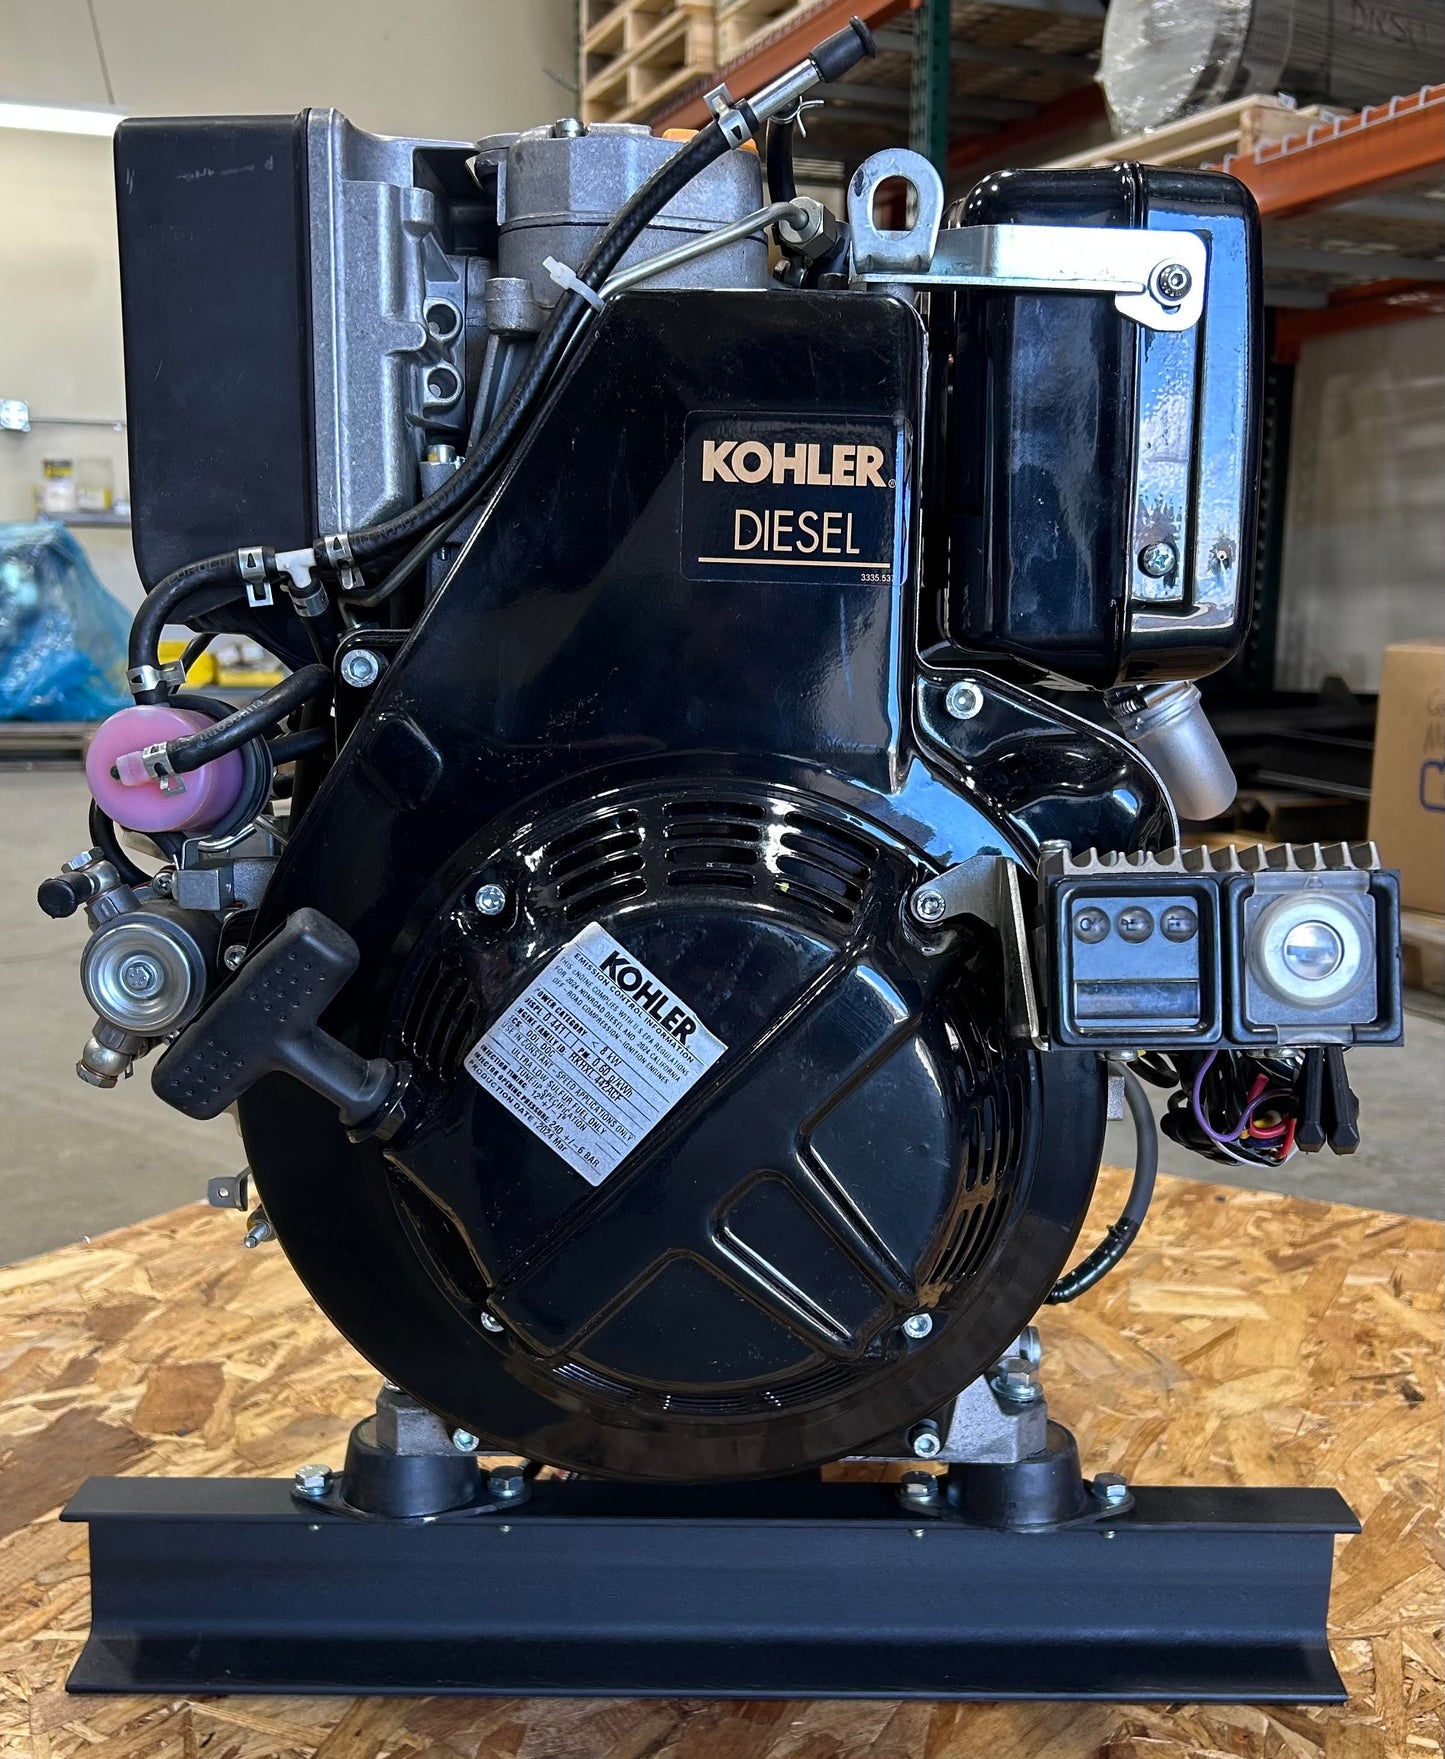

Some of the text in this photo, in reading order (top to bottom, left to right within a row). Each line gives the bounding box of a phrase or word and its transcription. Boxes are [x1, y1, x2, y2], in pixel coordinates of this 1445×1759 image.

[702, 440, 887, 488] KOHLER
[734, 509, 860, 554] DIESEL
[534, 1024, 558, 1046] FAMILY
[553, 965, 567, 978] FOR
[578, 987, 605, 1013] NONROAD
[604, 1011, 623, 1030] DIESEL
[622, 1028, 635, 1040] AND
[649, 1052, 680, 1082] CALIFORNIA
[573, 952, 694, 1063] EMISSION CONTROL INFORMATION
[591, 985, 619, 1011] COMPLIES
[618, 1009, 633, 1025] WITH
[652, 1042, 689, 1076] REGULATIONS
[599, 950, 697, 1045] KOHLER
[479, 1044, 508, 1071] INJECTION
[500, 1020, 515, 1034] USE
[574, 1088, 617, 1127] APPLICATIONS
[614, 1124, 633, 1141] ONLY
[510, 1047, 607, 1134] ULTRA LOW SULFUR FUEL ONLY
[515, 1065, 587, 1131] TUNEUP SPECIFICATION
[645, 1061, 669, 1084] ENGINES
[466, 1059, 515, 1103] PRODUCTION
[513, 1102, 534, 1122] DATE
[551, 1137, 567, 1151] Mar
[472, 1051, 499, 1076] INJECTOR
[497, 1074, 522, 1097] OPENING
[548, 1120, 563, 1134] 240
[583, 1151, 599, 1167] BAR
